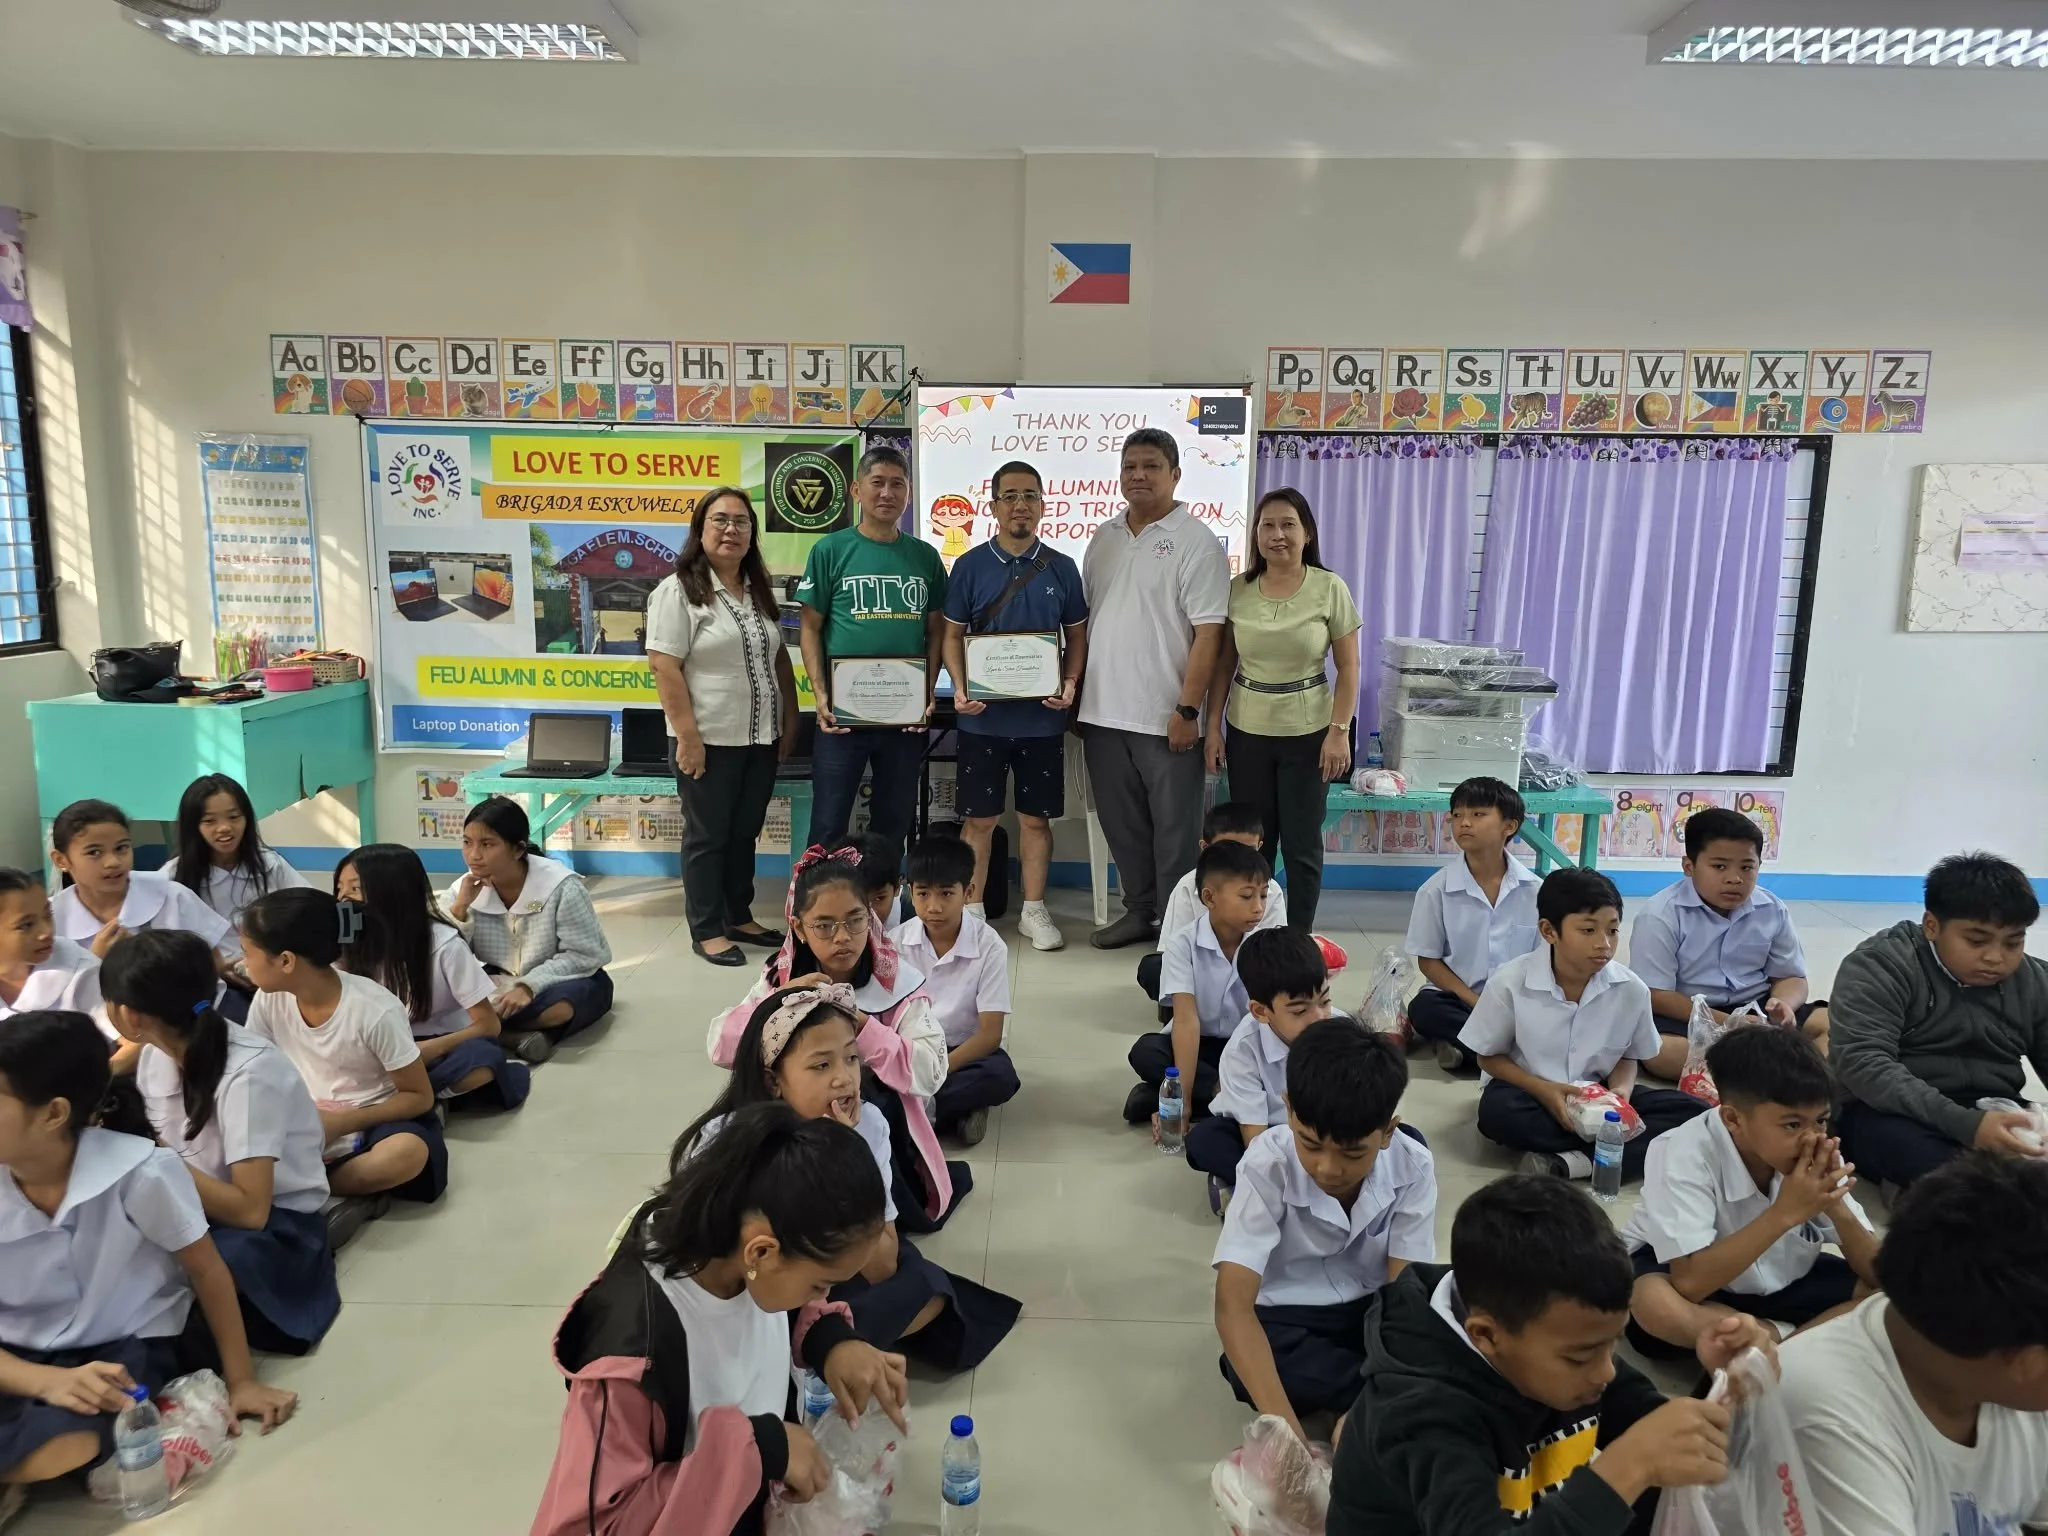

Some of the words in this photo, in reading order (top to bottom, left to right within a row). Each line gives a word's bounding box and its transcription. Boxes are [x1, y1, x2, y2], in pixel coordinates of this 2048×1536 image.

[279, 340, 318, 372] Aa
[337, 341, 376, 373] Bb
[394, 343, 432, 374] Cc
[451, 343, 491, 375] Dd
[513, 344, 547, 376] Ee
[571, 345, 605, 377] Ff
[626, 347, 664, 384] Gg
[682, 347, 724, 379] Hh
[746, 349, 773, 380] Ii
[801, 349, 831, 388] Jj
[857, 351, 897, 382] Kk
[1397, 355, 1432, 387] Rr
[1455, 355, 1492, 387] Ss
[1515, 355, 1554, 387] Tt
[1576, 355, 1614, 387] Uu
[1637, 356, 1676, 388] Vv
[1278, 353, 1314, 393] Pp
[1333, 354, 1377, 393] Qq
[1694, 356, 1741, 389] Ww
[1755, 357, 1799, 389] Xx
[1821, 357, 1857, 398] Yy
[1879, 357, 1919, 389] Zz
[1012, 412, 1091, 431] THANK
[1099, 413, 1147, 431] YOU
[1203, 405, 1217, 414] PC
[1658, 422, 1677, 430] Venus
[991, 434, 1049, 452] LOVE
[1058, 435, 1088, 452] TO
[1097, 435, 1123, 453] SE
[387, 451, 408, 496] LOVE
[406, 443, 431, 458] TO
[433, 449, 462, 501] SERVE
[513, 450, 582, 475] LOVE
[589, 452, 628, 475] TO
[636, 453, 721, 478] SERVE
[495, 494, 583, 514] BRIGADA
[587, 495, 697, 515] ESKUWELA
[634, 533, 679, 564] SCHO
[430, 666, 466, 684] FEU
[470, 666, 537, 687] ALUMNI
[543, 669, 557, 687] &
[561, 669, 657, 689] CONCERNE
[412, 717, 456, 732] Laptop
[460, 718, 520, 732] Donation
[421, 778, 433, 800] 1
[420, 817, 440, 838] 11
[585, 818, 604, 841] 14
[639, 818, 658, 840] 15
